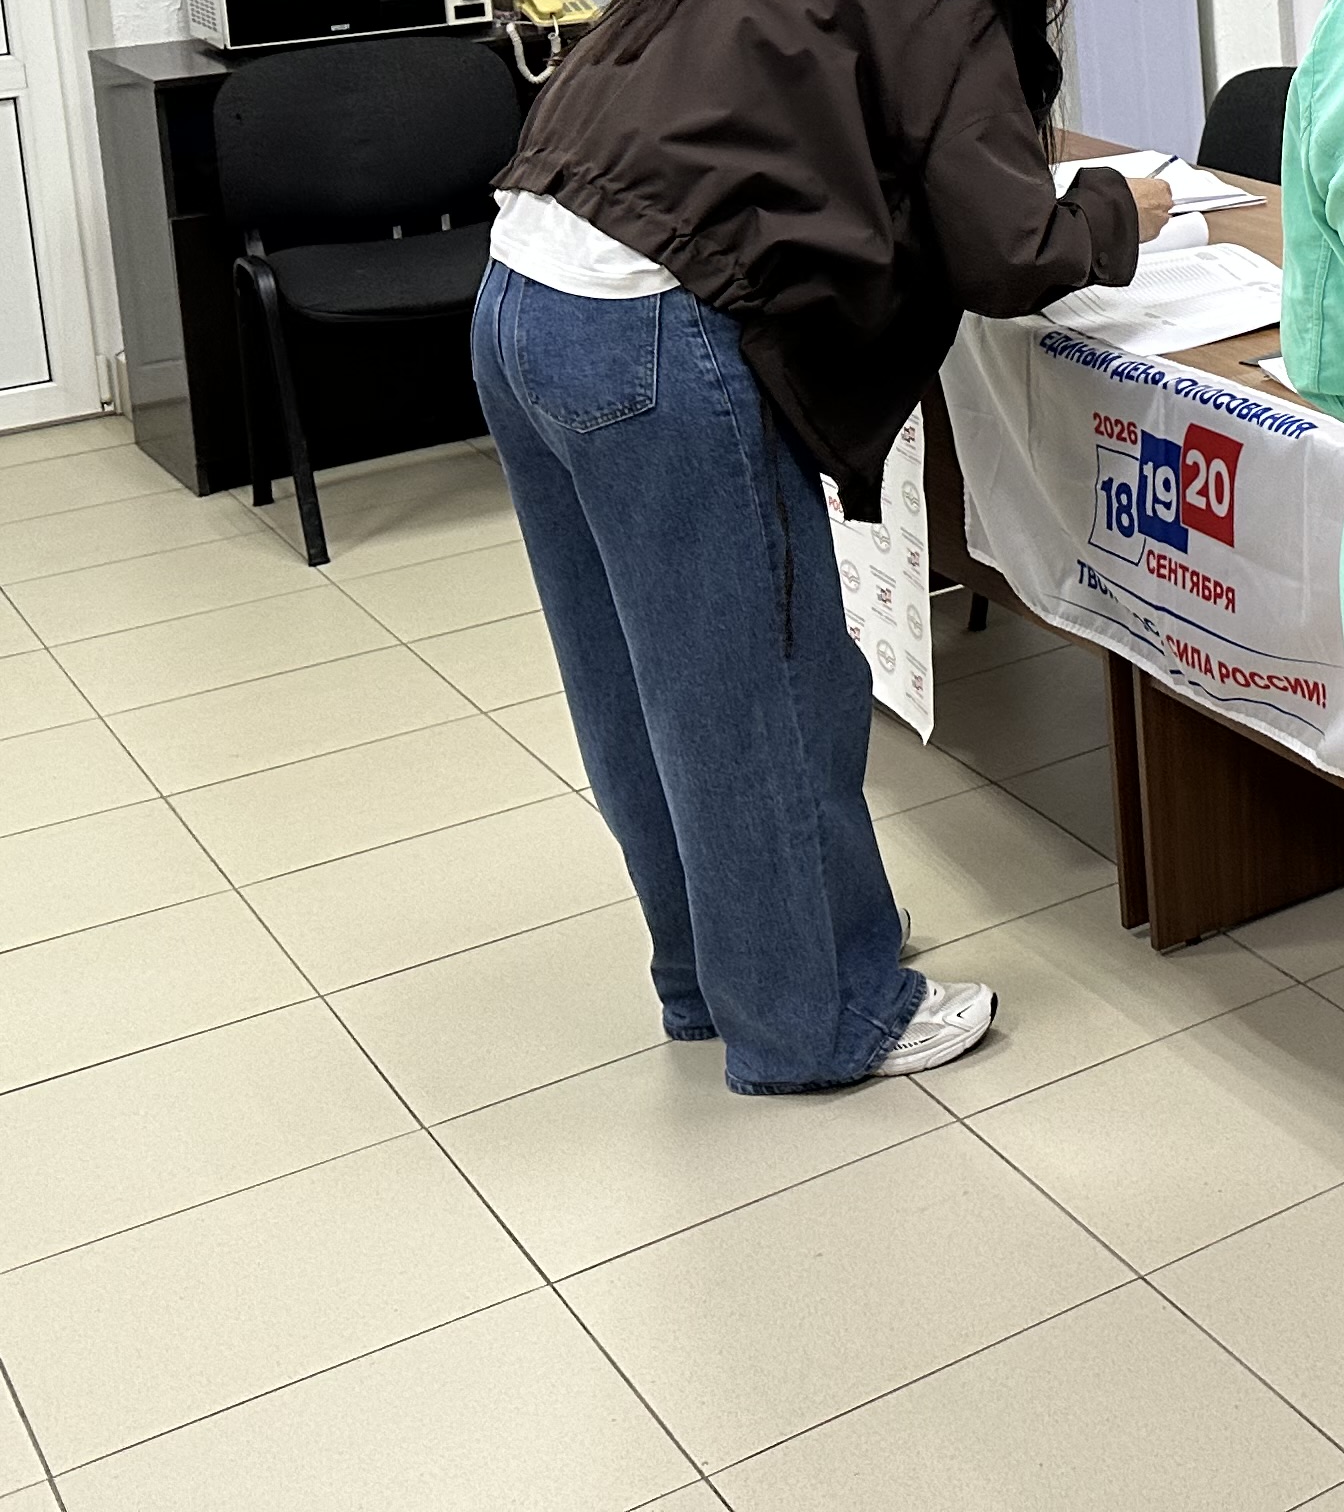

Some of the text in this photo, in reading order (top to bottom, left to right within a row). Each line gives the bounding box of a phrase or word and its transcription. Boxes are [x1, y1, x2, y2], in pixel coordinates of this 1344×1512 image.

[1039, 331, 1122, 372] ЕДИНЫЙ
[1110, 361, 1167, 385] ДЕНЬ
[1093, 412, 1138, 445] 2026
[1100, 476, 1135, 538] 18
[1143, 461, 1178, 523] 19
[1185, 449, 1230, 517] 20
[1146, 549, 1236, 614] СЕНТЯБРЯ
[1165, 634, 1327, 709] СИЛА РОССИИ!
